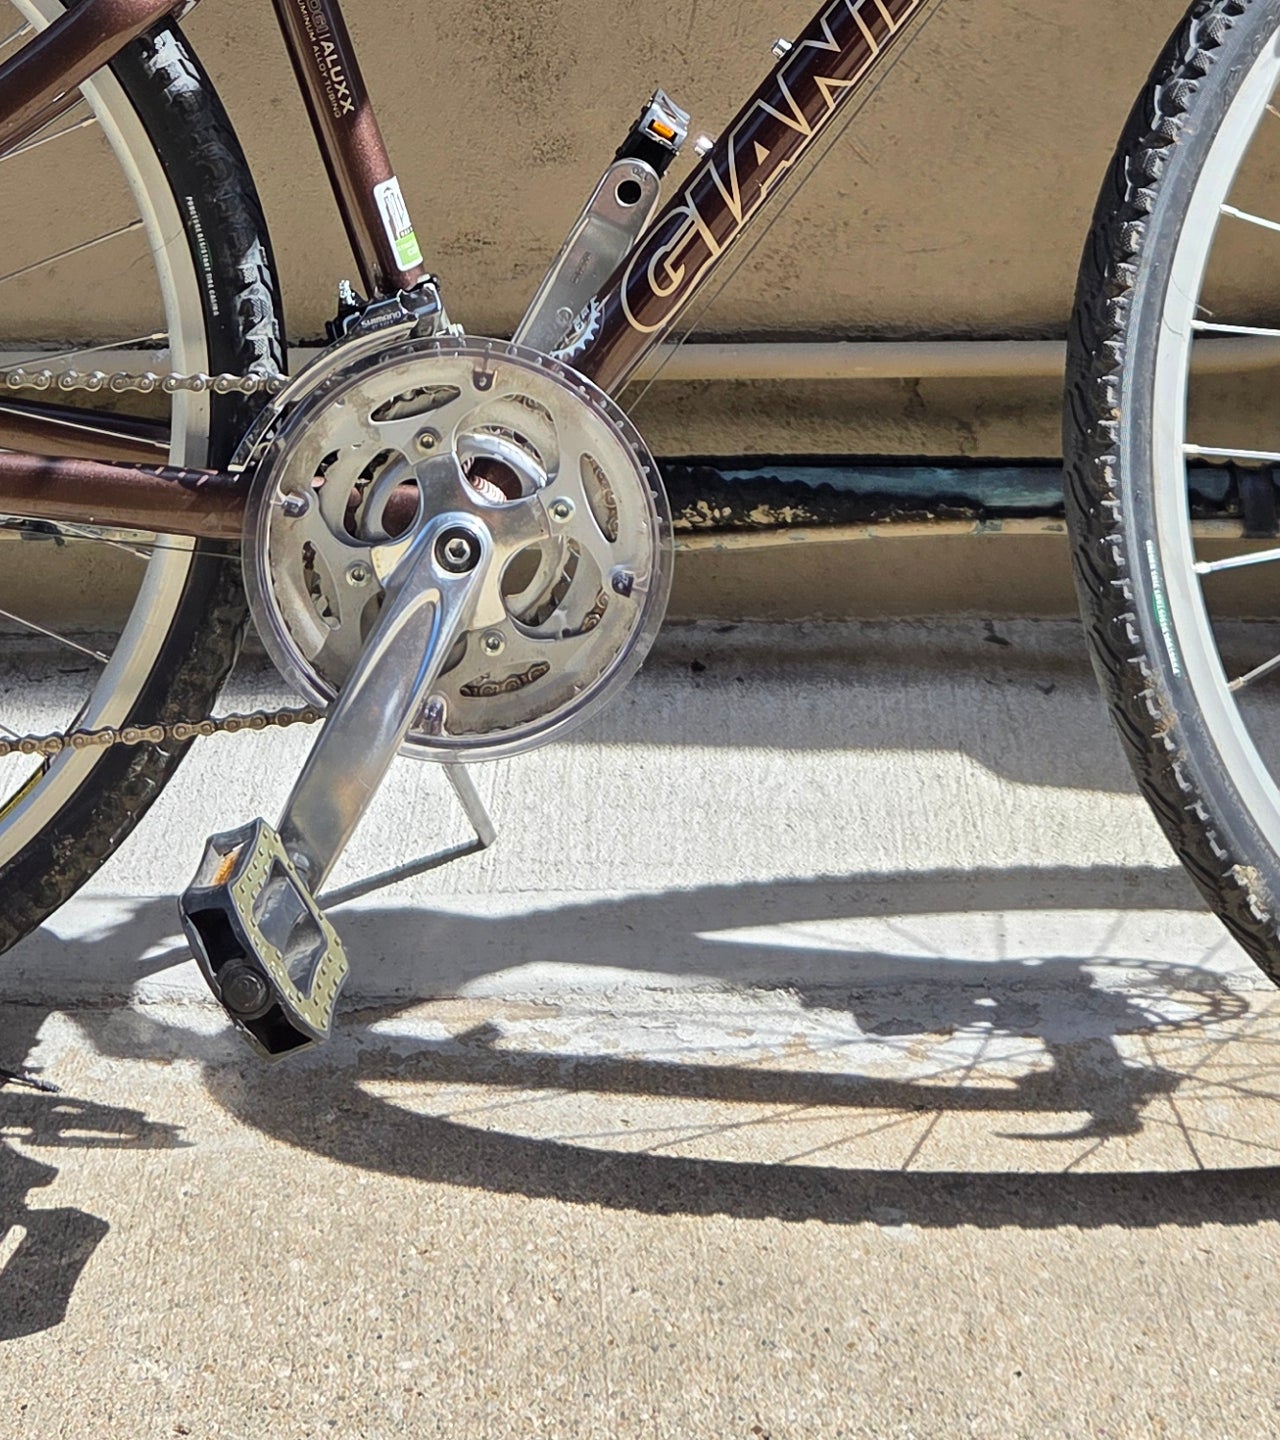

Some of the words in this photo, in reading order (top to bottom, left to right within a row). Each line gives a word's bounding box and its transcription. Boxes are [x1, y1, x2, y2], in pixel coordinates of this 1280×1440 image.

[313, 44, 328, 78] ALLOY
[324, 80, 341, 119] TUBING
[320, 40, 355, 115] ALUXX
